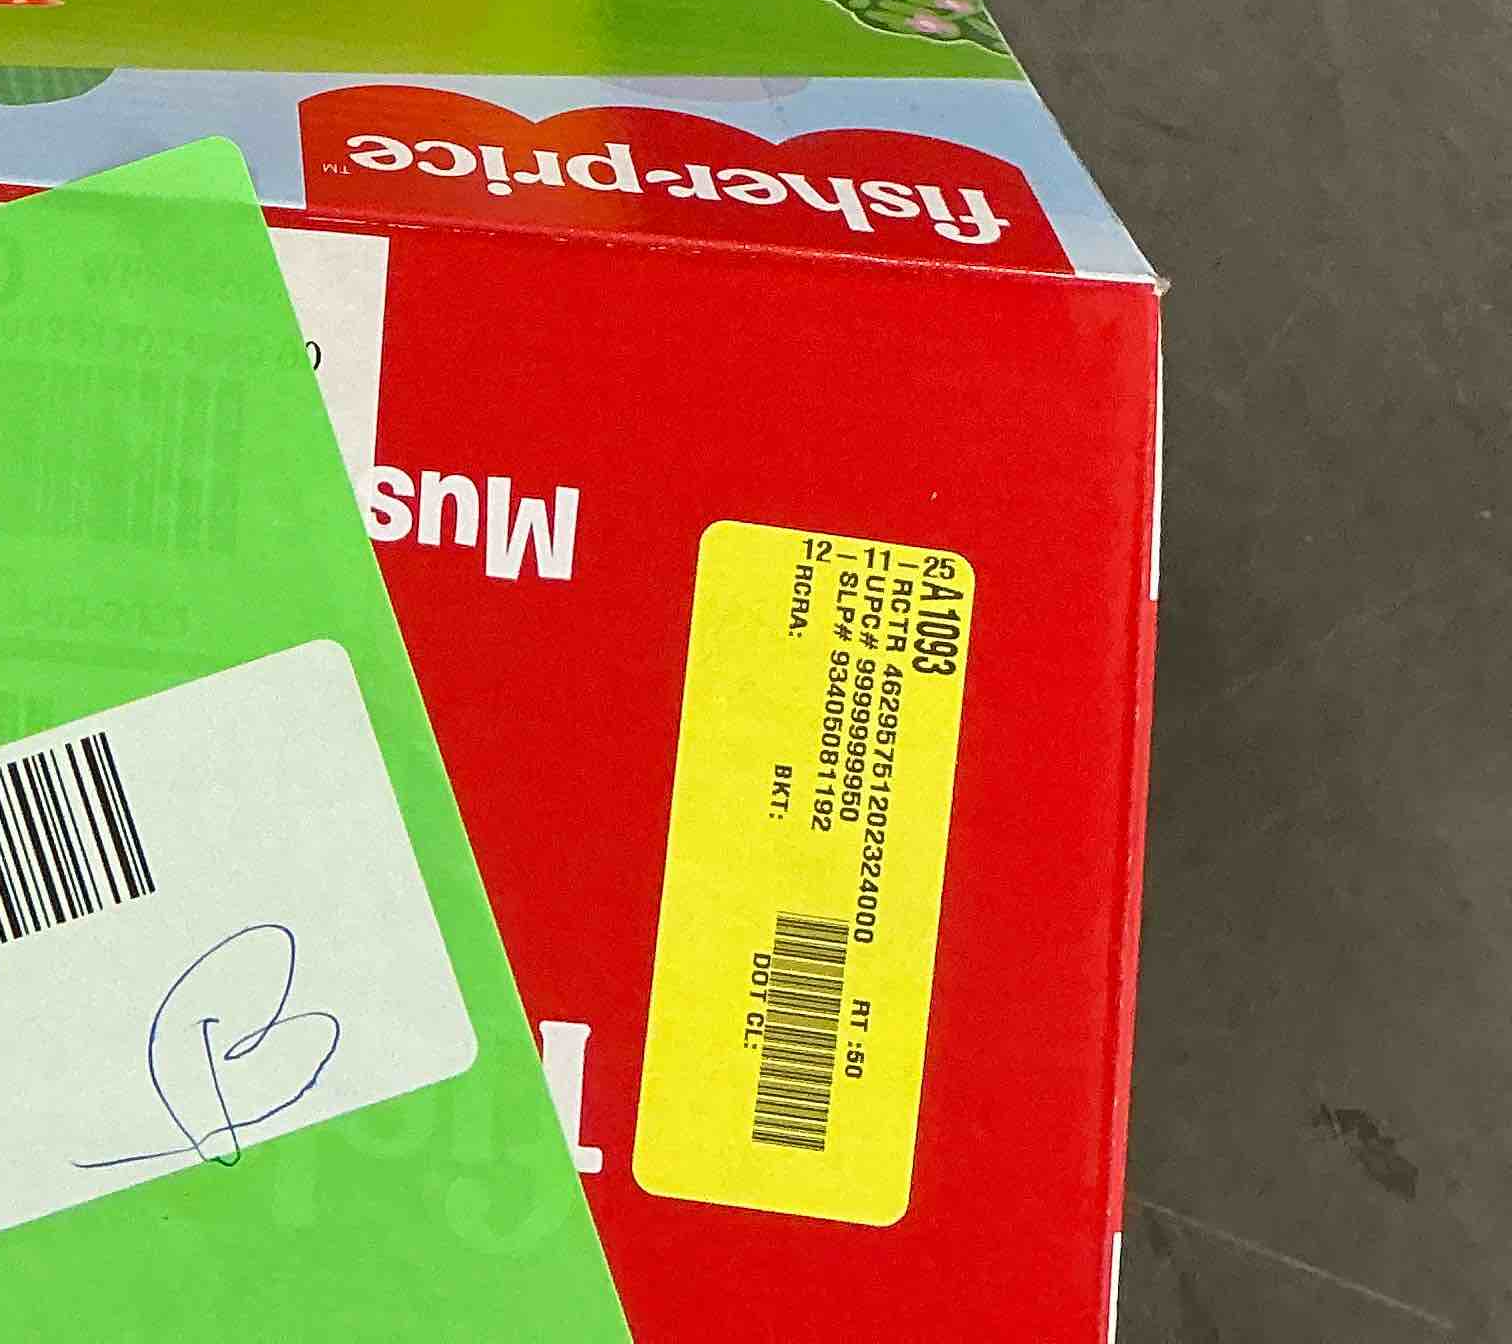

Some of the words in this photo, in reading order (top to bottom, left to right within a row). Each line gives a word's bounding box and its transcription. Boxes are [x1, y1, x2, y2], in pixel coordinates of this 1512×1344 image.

[346, 134, 1011, 245] fisher-price
[788, 563, 814, 639] RCRA:
[833, 570, 859, 643] SLP#
[859, 574, 887, 651] UPC#
[885, 577, 915, 653] RCTR
[812, 649, 850, 833] 93405081192
[838, 658, 876, 823] 9999999950
[769, 763, 793, 821] BKT:
[853, 662, 904, 945] 46295751202324000
[749, 951, 772, 1004] DOT
[849, 998, 872, 1033] RT
[743, 1011, 765, 1050] CL:
